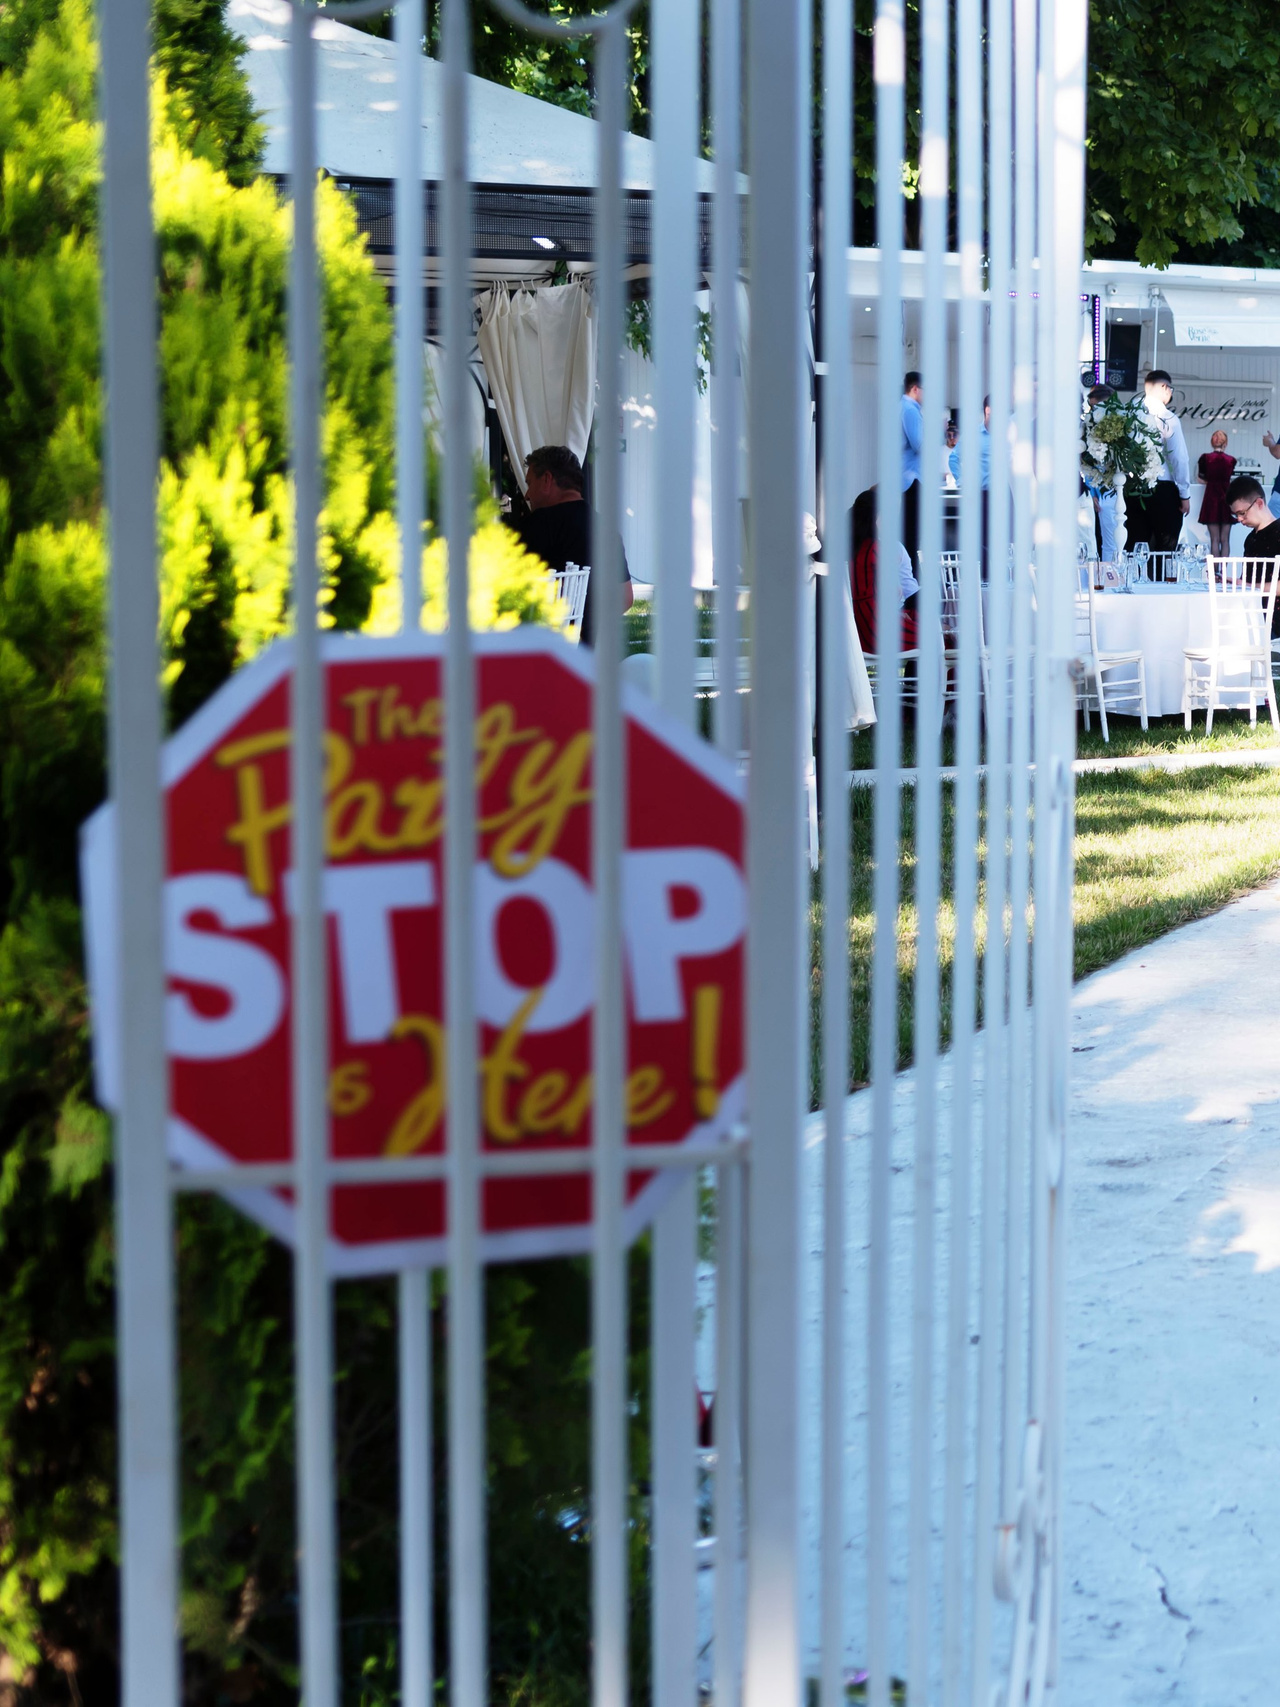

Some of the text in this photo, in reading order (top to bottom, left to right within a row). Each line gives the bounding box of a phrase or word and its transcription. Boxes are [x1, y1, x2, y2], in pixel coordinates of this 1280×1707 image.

[1240, 398, 1269, 409] pool
[341, 683, 446, 745] The
[165, 845, 748, 1062] STOP
